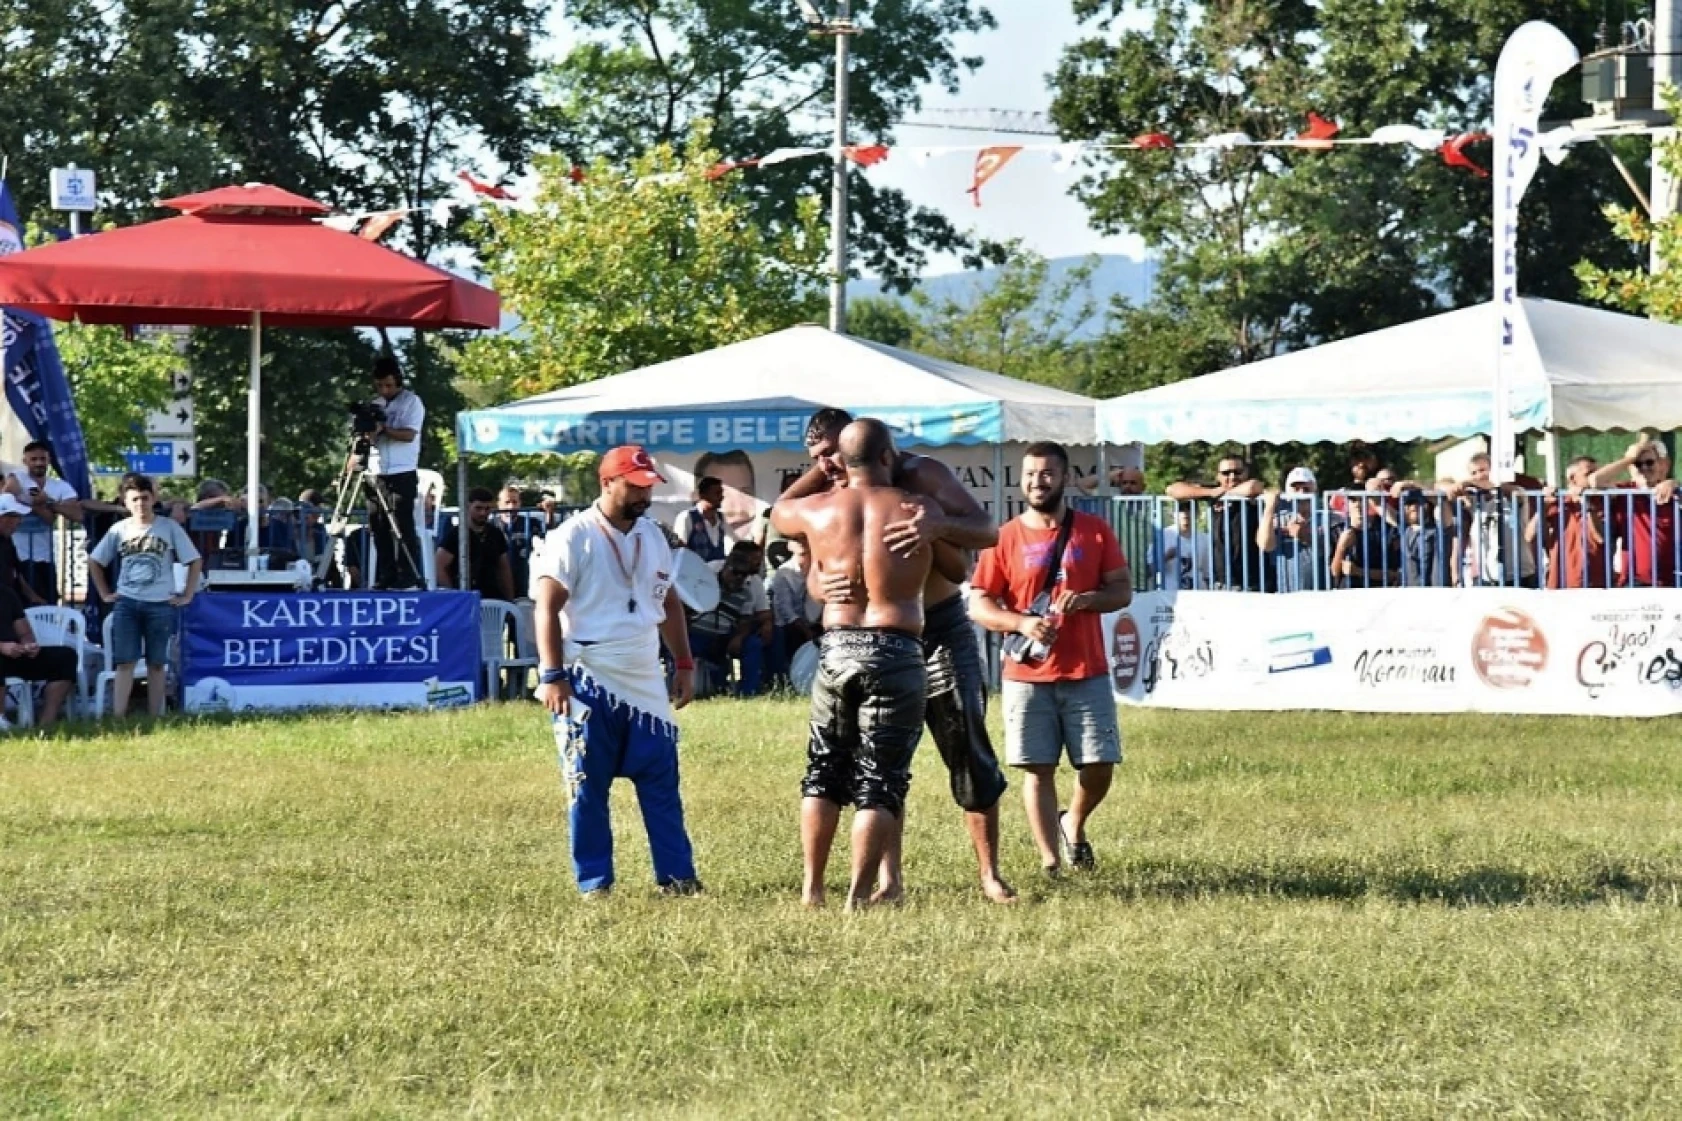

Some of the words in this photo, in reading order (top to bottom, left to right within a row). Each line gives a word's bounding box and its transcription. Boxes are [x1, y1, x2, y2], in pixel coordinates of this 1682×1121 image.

[522, 417, 695, 447] KARTEPE
[241, 597, 422, 628] KARTEPE
[222, 628, 440, 667] BELEDİYESİ
